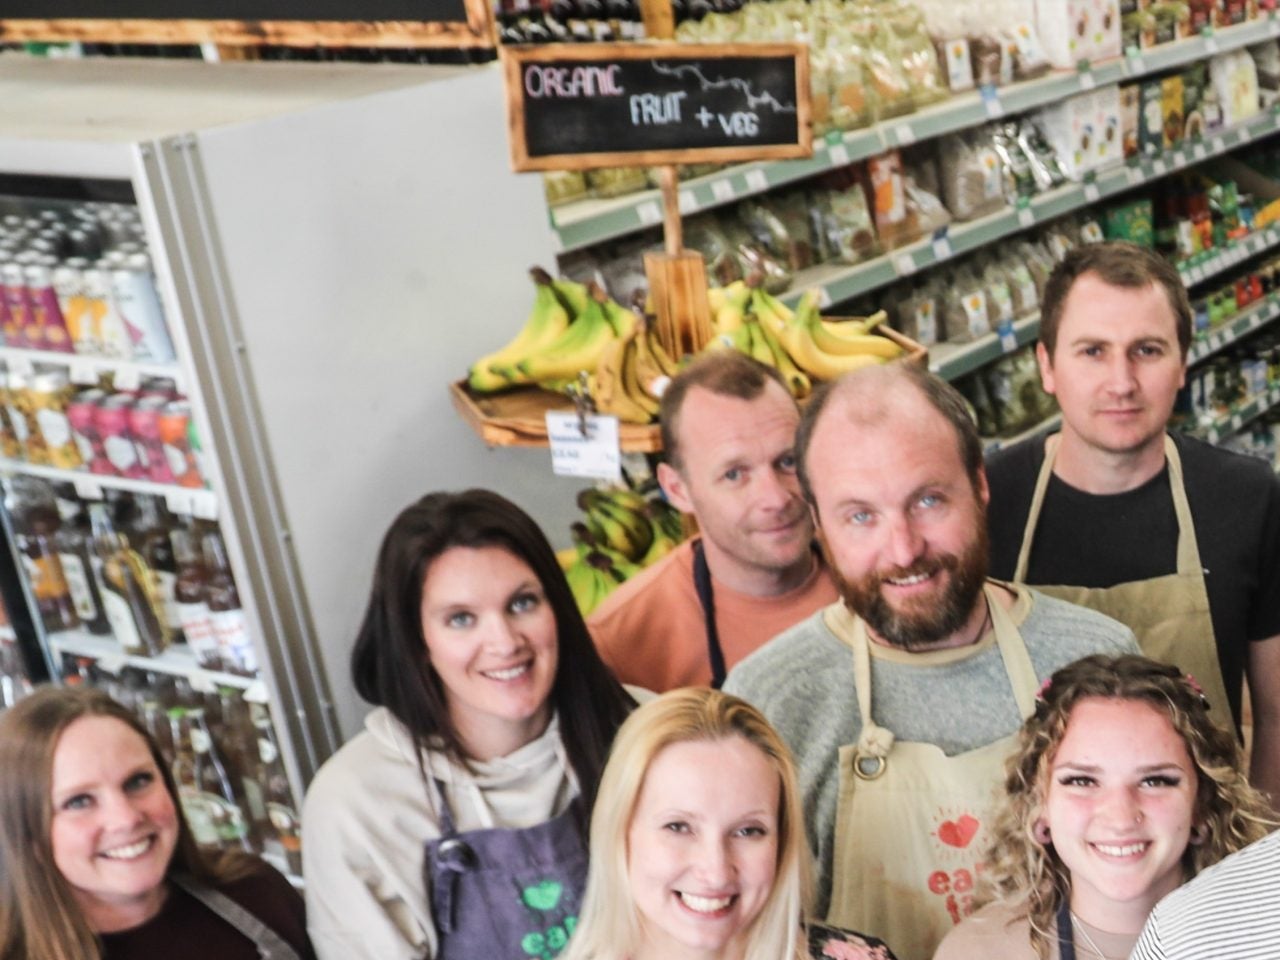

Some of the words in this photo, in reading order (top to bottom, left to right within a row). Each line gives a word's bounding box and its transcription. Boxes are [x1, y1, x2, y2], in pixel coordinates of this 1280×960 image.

[525, 64, 624, 98] ORGANIC
[629, 90, 687, 126] FRUIT
[717, 111, 760, 137] VEG
